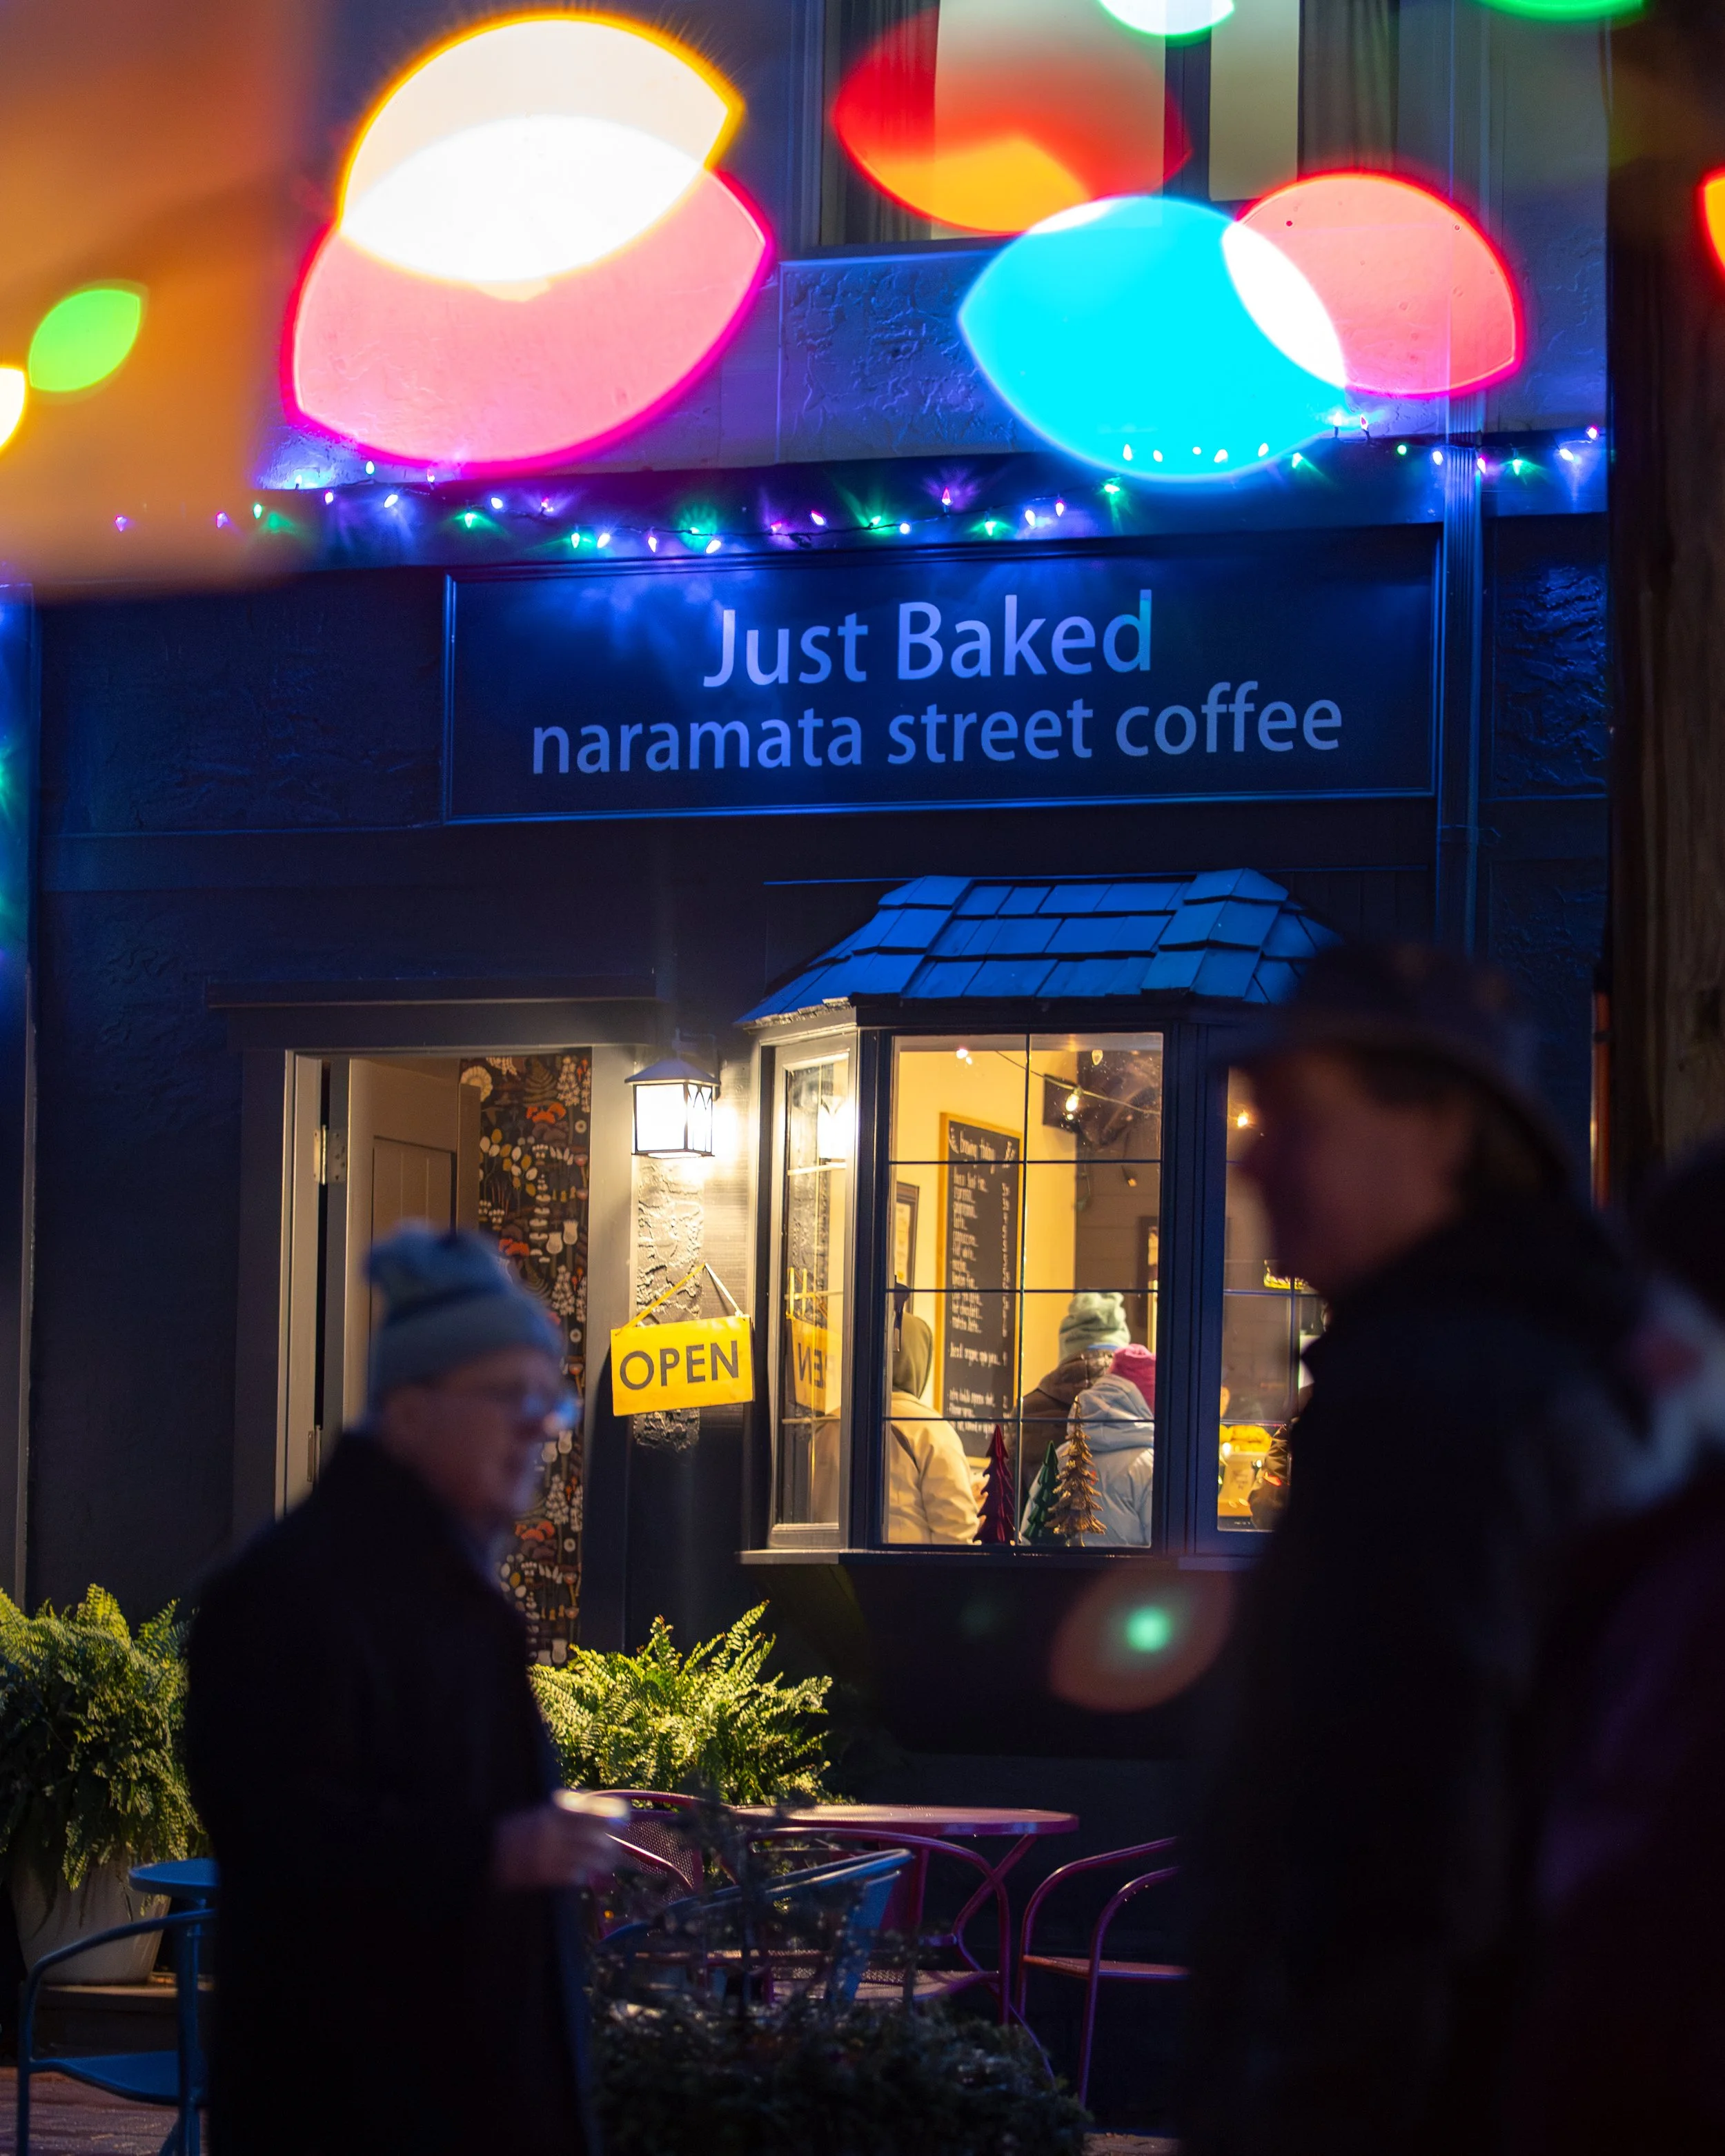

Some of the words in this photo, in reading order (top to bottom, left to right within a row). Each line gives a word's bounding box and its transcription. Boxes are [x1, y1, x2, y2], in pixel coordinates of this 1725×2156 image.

[703, 609, 867, 687] Just
[898, 589, 1152, 680] Baked
[533, 709, 862, 774] naramata
[888, 699, 1093, 763] street
[1116, 681, 1342, 756] coffee
[620, 1341, 739, 1390] OPEN
